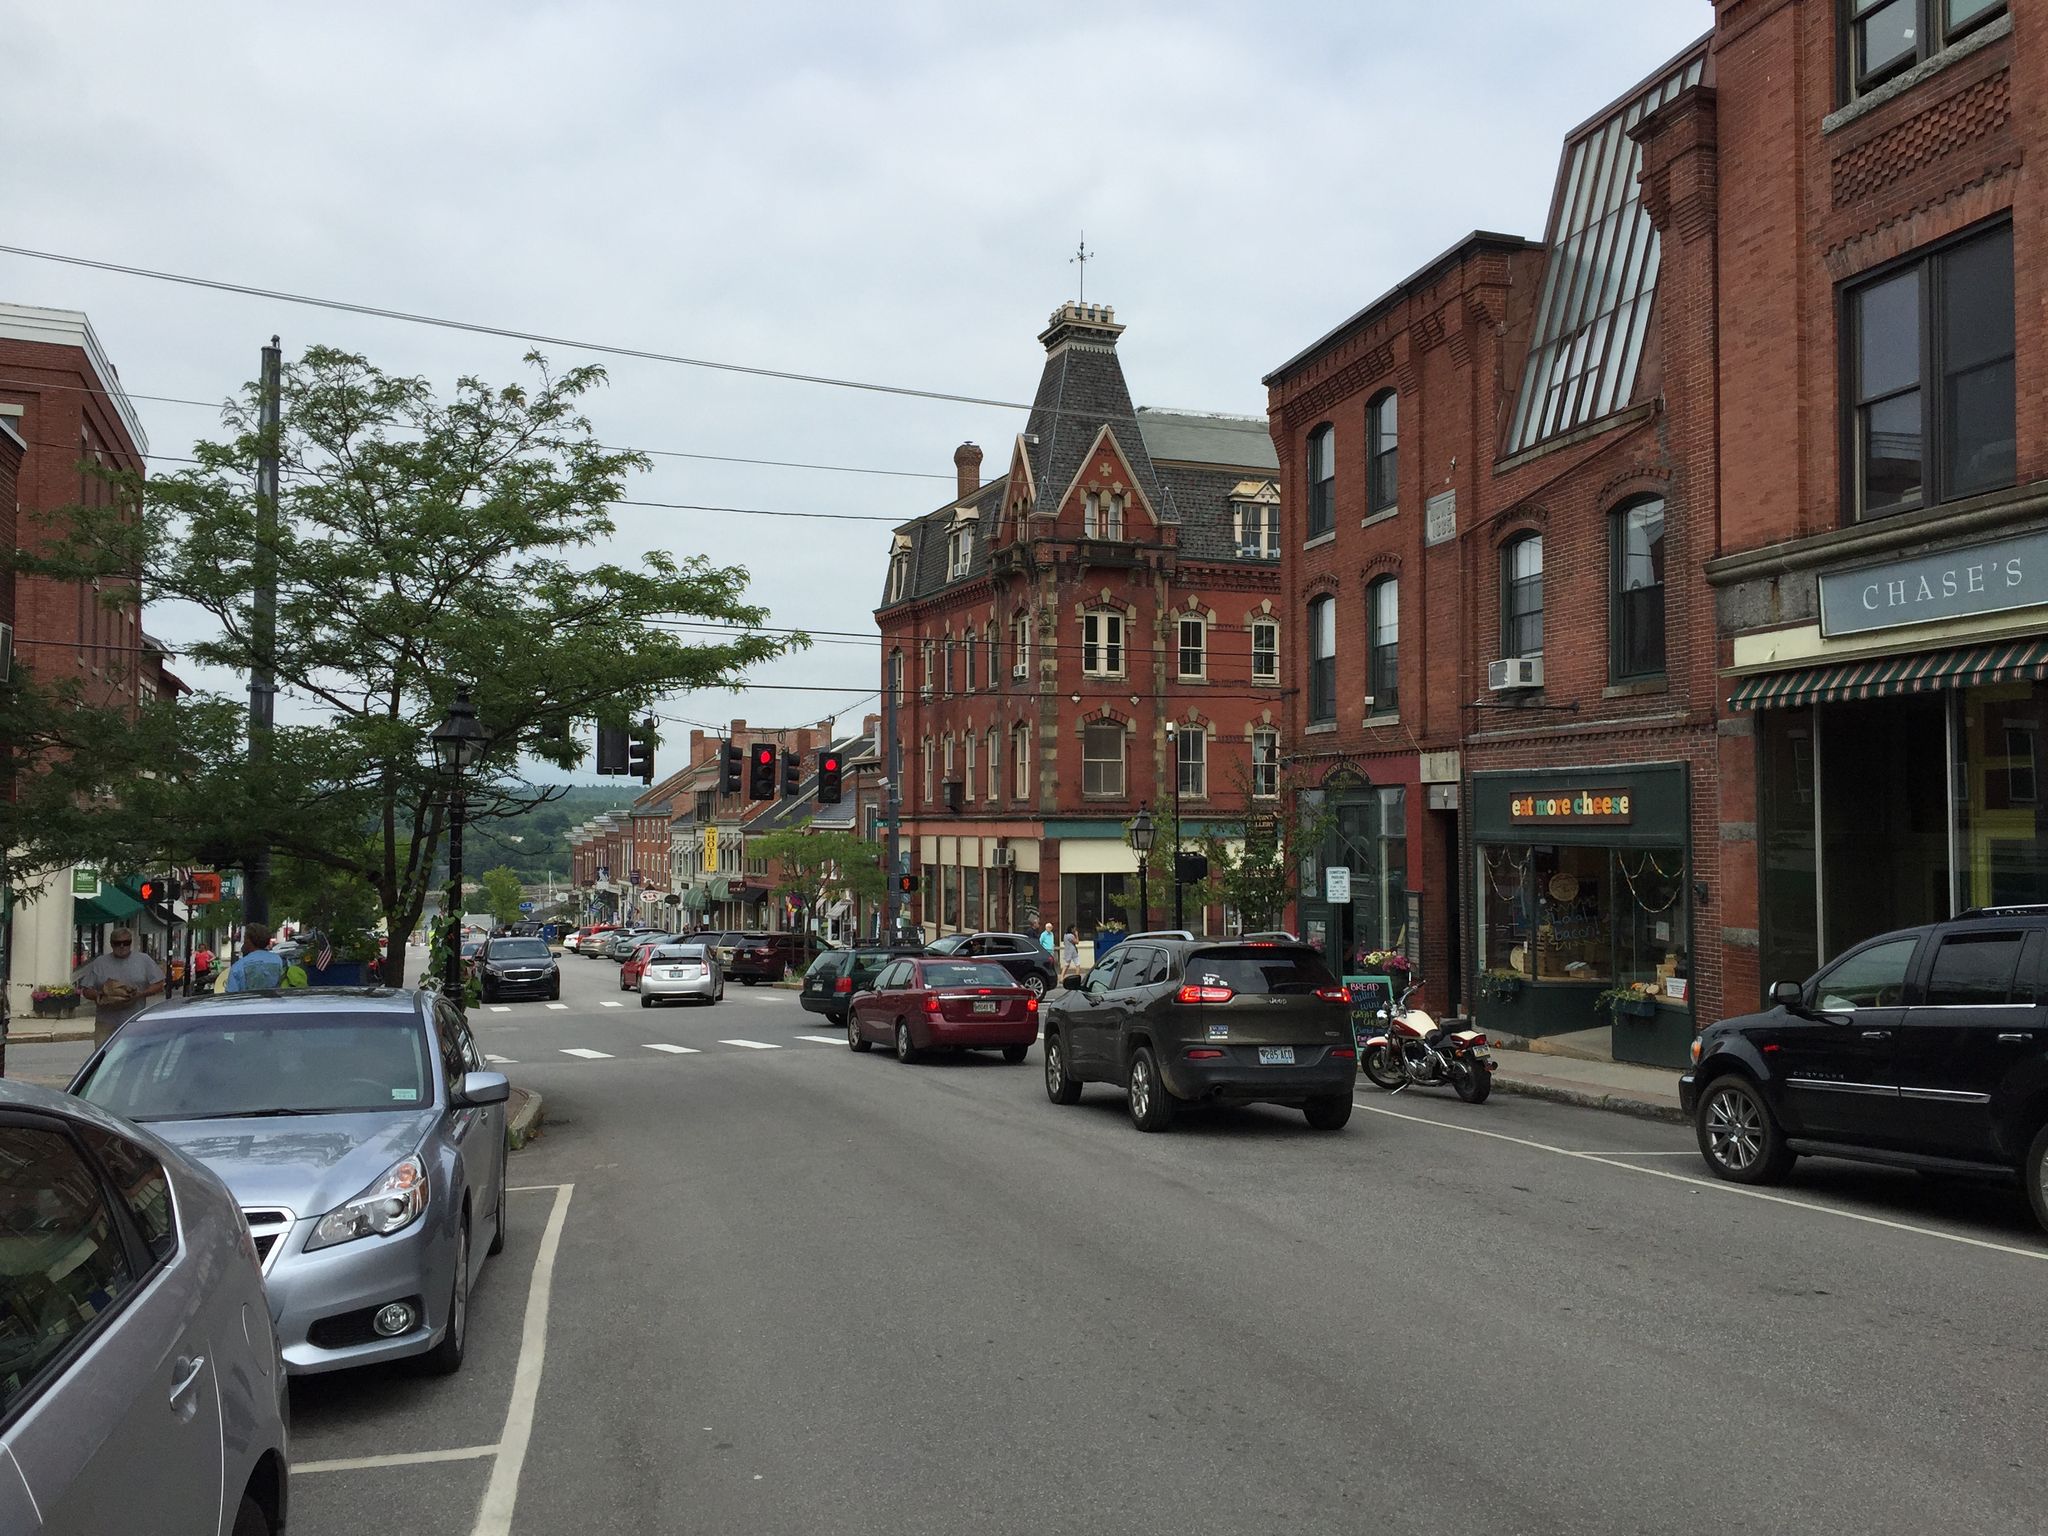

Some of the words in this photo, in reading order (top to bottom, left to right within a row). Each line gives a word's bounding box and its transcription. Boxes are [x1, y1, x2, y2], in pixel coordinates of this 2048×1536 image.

[1863, 558, 2023, 610] CHASE'S
[1512, 797, 1533, 816] eat
[1536, 799, 1571, 816] more
[1573, 791, 1629, 815] cheese
[707, 835, 715, 867] HOTEL
[1350, 983, 1380, 992] BREAD
[1268, 997, 1288, 1005] Jeep
[1265, 1049, 1279, 1060] 285
